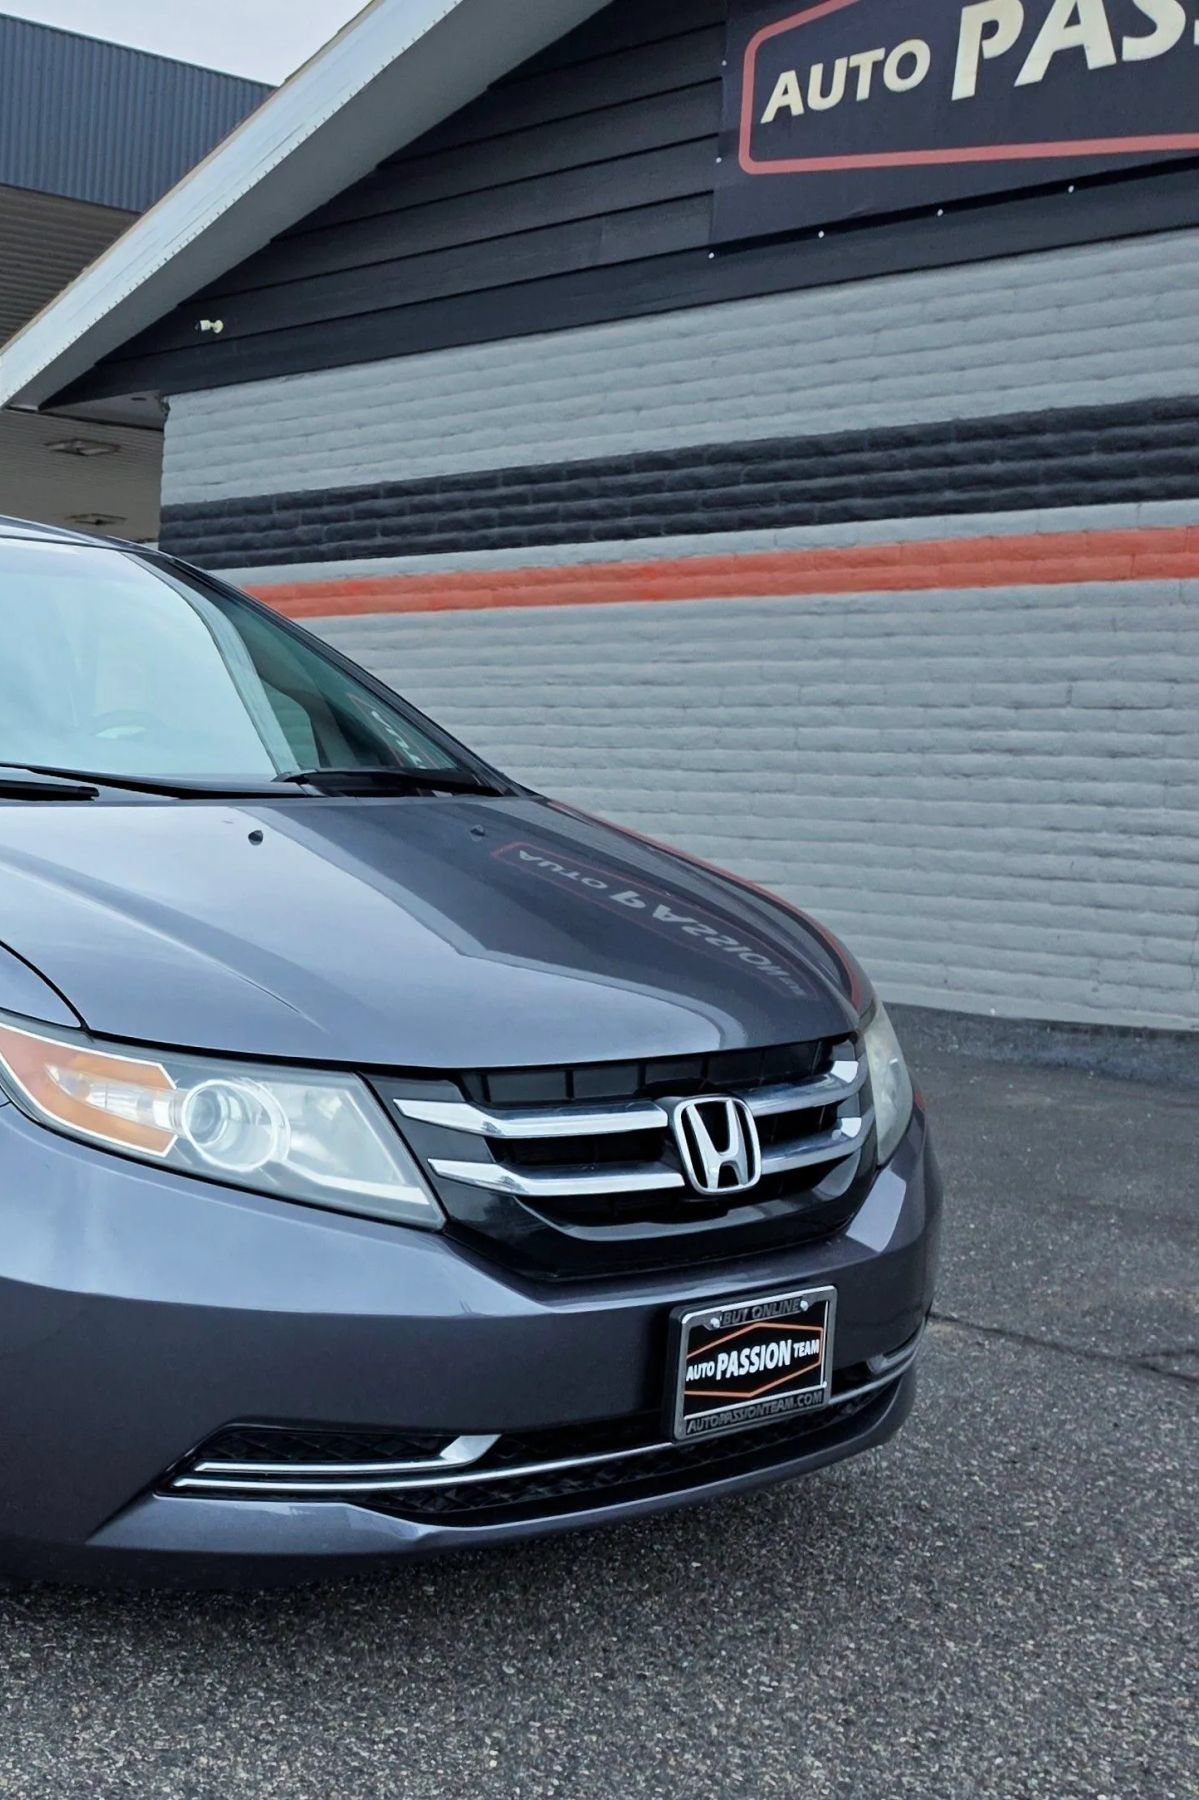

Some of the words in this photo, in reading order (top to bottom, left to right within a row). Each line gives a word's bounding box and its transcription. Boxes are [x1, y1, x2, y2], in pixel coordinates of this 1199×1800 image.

[760, 38, 932, 124] AUTO
[951, 0, 1199, 101] PAS
[722, 1308, 748, 1326] BUY
[751, 1298, 801, 1319] ONLINE
[685, 1361, 715, 1382] AUTO
[716, 1339, 792, 1380] PASSION
[793, 1339, 820, 1359] TEAM
[686, 1391, 823, 1434] AUTOPASSIONTEAM.COM
